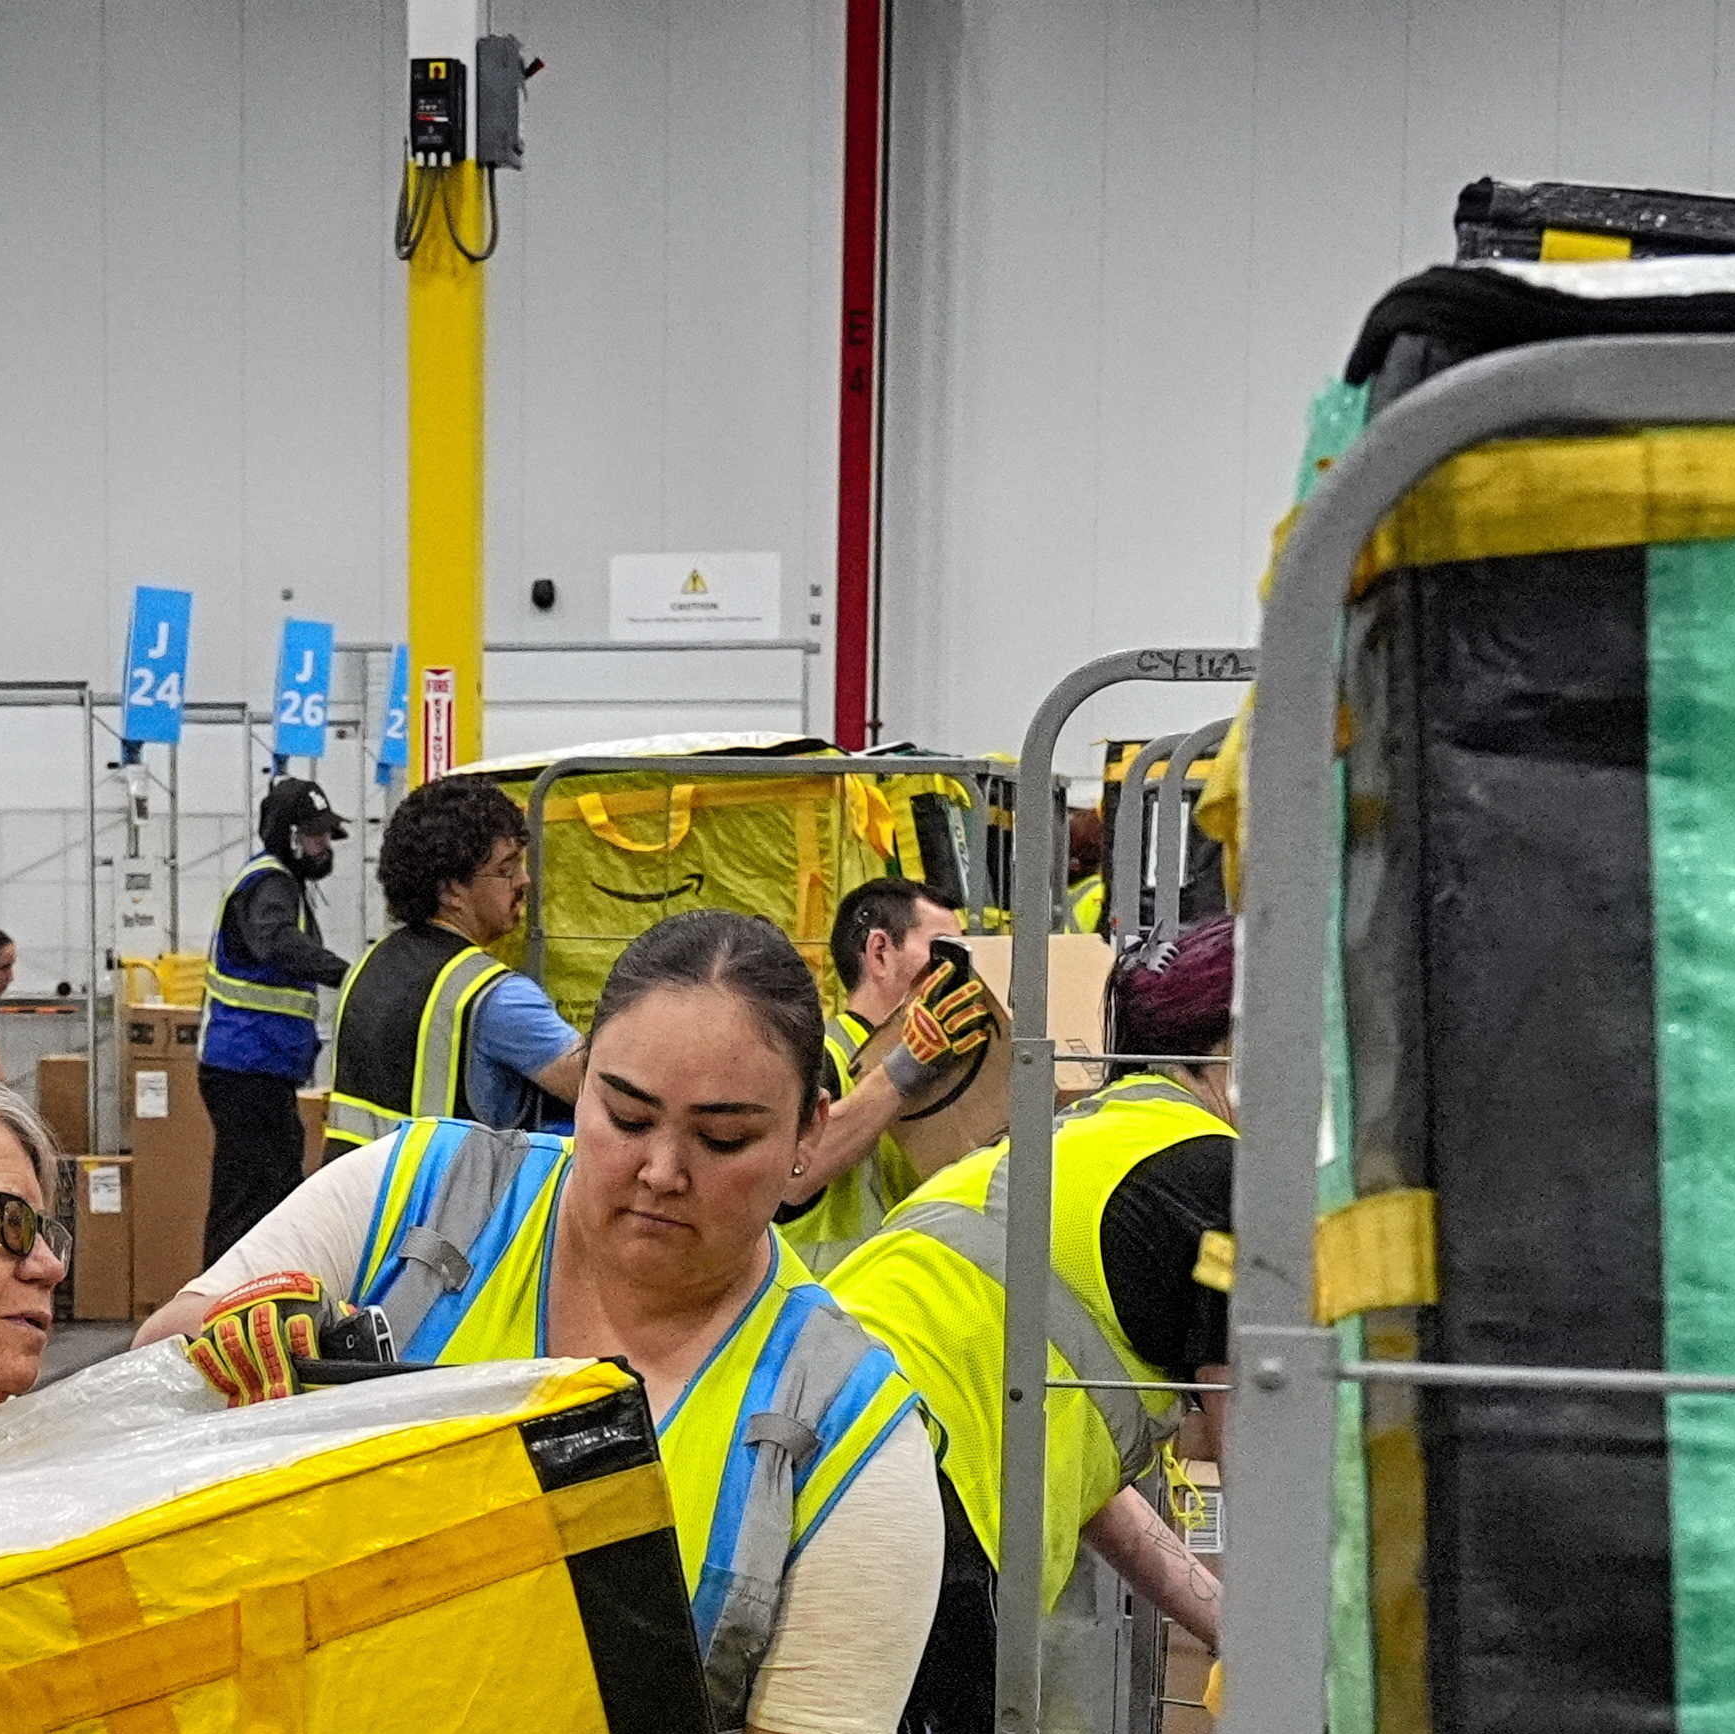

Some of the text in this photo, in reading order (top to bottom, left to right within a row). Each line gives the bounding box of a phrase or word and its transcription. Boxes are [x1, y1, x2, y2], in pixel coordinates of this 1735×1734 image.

[147, 620, 170, 660] J
[294, 649, 315, 684] J
[129, 668, 182, 710] 24
[279, 690, 325, 728] 26
[386, 709, 408, 740] 2
